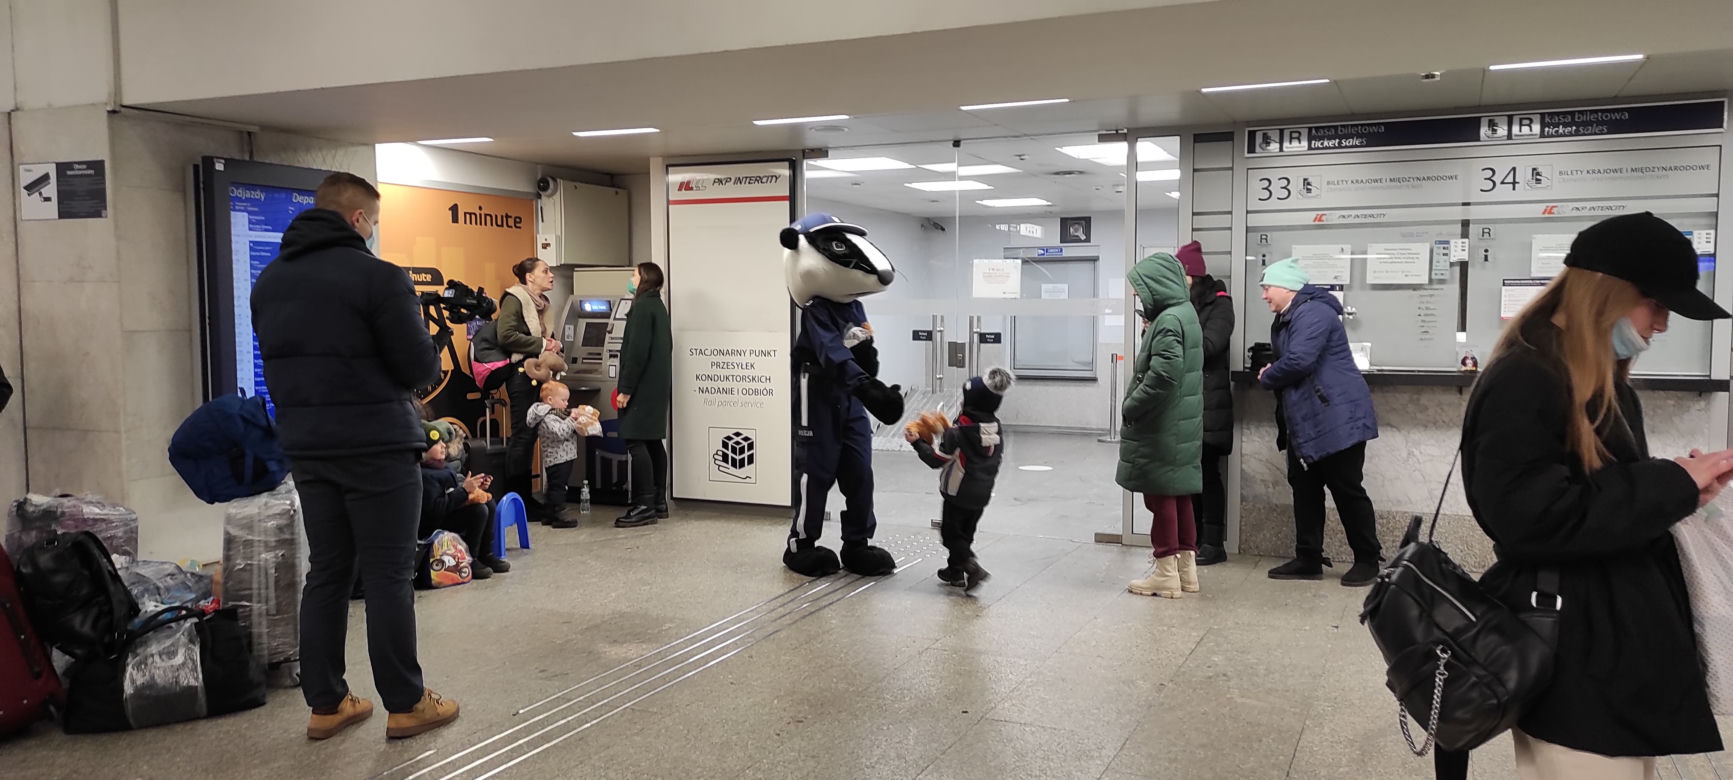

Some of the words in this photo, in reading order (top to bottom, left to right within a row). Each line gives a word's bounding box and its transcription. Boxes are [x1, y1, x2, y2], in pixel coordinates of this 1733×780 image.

[1544, 112, 1572, 123] kasa
[1575, 110, 1629, 122] biletowa
[1311, 126, 1335, 136] kasa
[1337, 123, 1385, 136] biletowa
[1544, 125, 1576, 136] ticket
[1578, 124, 1608, 134] sales
[1311, 136, 1339, 148] ticket
[1340, 136, 1367, 147] sales
[1586, 167, 1624, 175] KRAJOWE
[712, 177, 732, 186] PKP
[733, 175, 782, 185] INTERCITY
[1350, 177, 1383, 185] KRAJOWE
[1480, 166, 1520, 193] 34
[229, 186, 265, 201] Odjazdy
[292, 192, 315, 204] Depa
[1258, 177, 1292, 201] 33
[448, 203, 459, 224] 1
[463, 205, 523, 229] minute
[409, 270, 432, 282] inute
[689, 347, 747, 357] STACJONARNY
[749, 348, 777, 358] PUNKT
[711, 361, 756, 370] PRZESYŁEK
[695, 373, 771, 384] KONDUKTORSKICH
[698, 386, 736, 396] NADANIE
[741, 386, 774, 397] ODBIÓR
[703, 398, 716, 407] Rail
[717, 398, 739, 408] parcel
[739, 399, 765, 408] service
